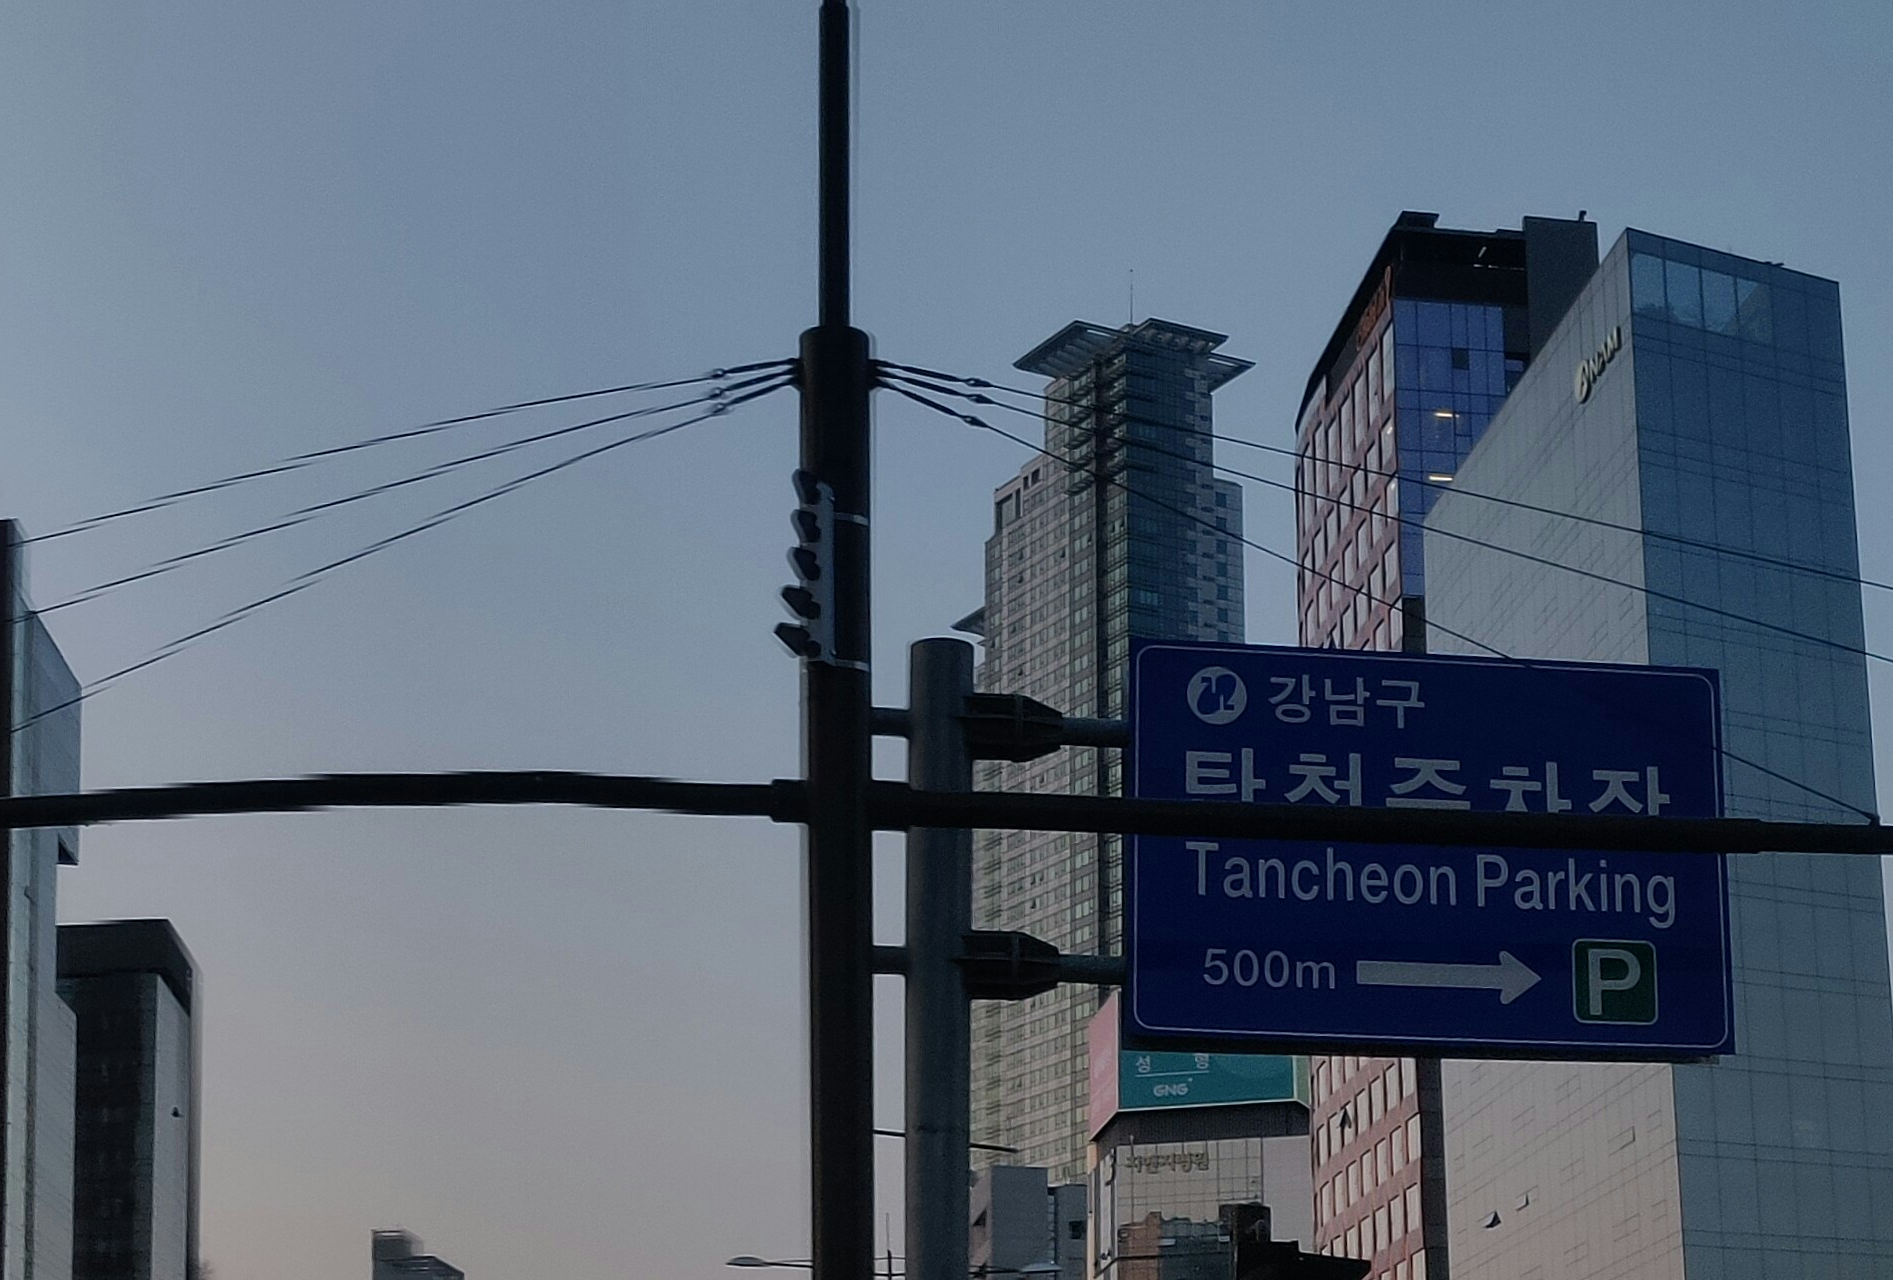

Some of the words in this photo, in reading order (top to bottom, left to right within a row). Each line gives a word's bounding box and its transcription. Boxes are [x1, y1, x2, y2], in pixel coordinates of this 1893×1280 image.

[1268, 673, 1426, 730] 강남구
[1184, 839, 1458, 907] Tancheon
[1475, 852, 1677, 930] Parking
[1202, 947, 1338, 990] 500m
[1587, 949, 1641, 1016] P
[1153, 1082, 1190, 1098] GNG
